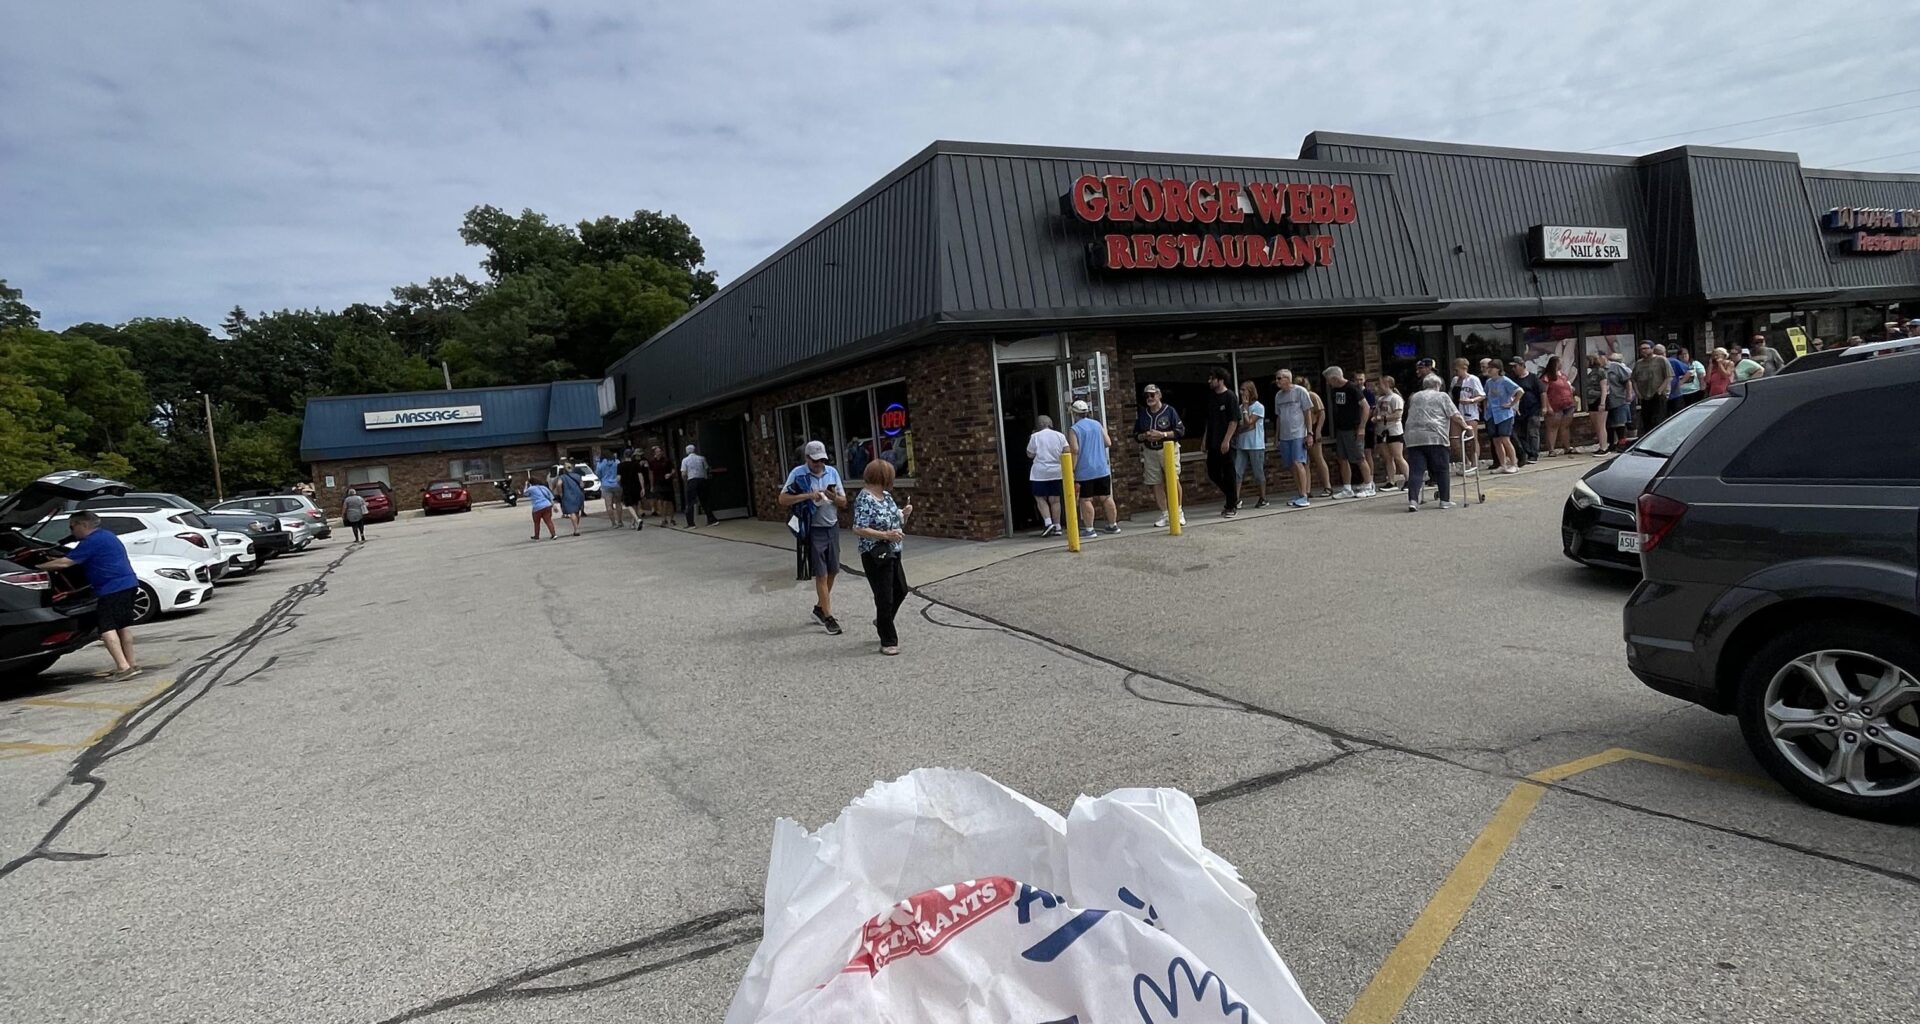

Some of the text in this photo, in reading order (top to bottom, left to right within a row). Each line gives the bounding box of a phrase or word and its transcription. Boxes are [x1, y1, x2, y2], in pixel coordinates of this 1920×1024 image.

[1073, 175, 1357, 224] GEORGE WEBB
[1561, 229, 1606, 249] Beautiful
[1104, 235, 1335, 269] RESTAURANT
[1571, 245, 1621, 257] NAIL & SPA
[395, 410, 460, 423] MASSAGE
[881, 411, 905, 429] OPEN
